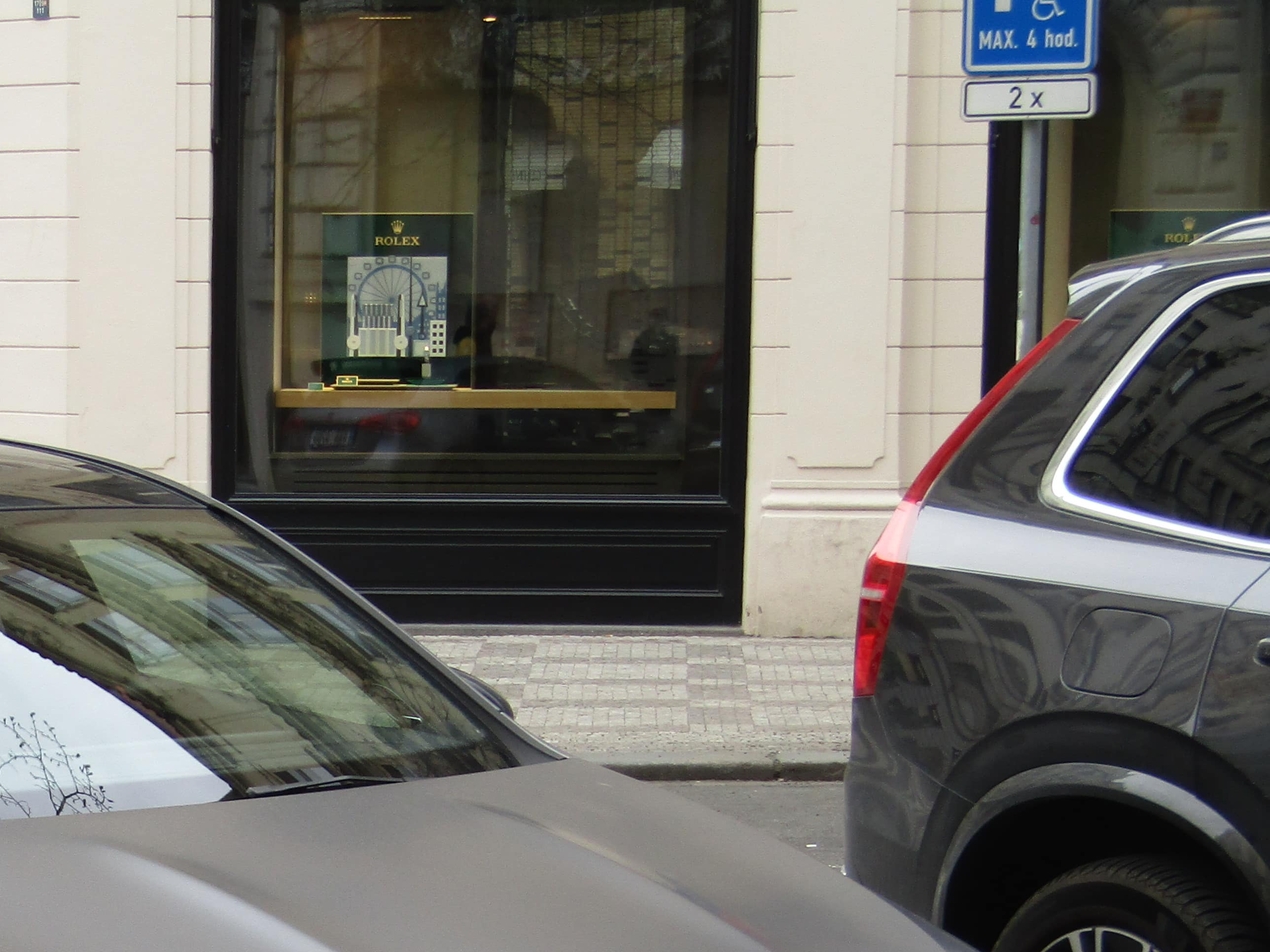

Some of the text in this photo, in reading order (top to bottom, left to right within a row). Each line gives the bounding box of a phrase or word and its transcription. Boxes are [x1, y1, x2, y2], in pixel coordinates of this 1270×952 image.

[978, 27, 1079, 50] MAX. 4 hod.
[1009, 86, 1045, 110] 2 x
[374, 236, 421, 247] ROLEX
